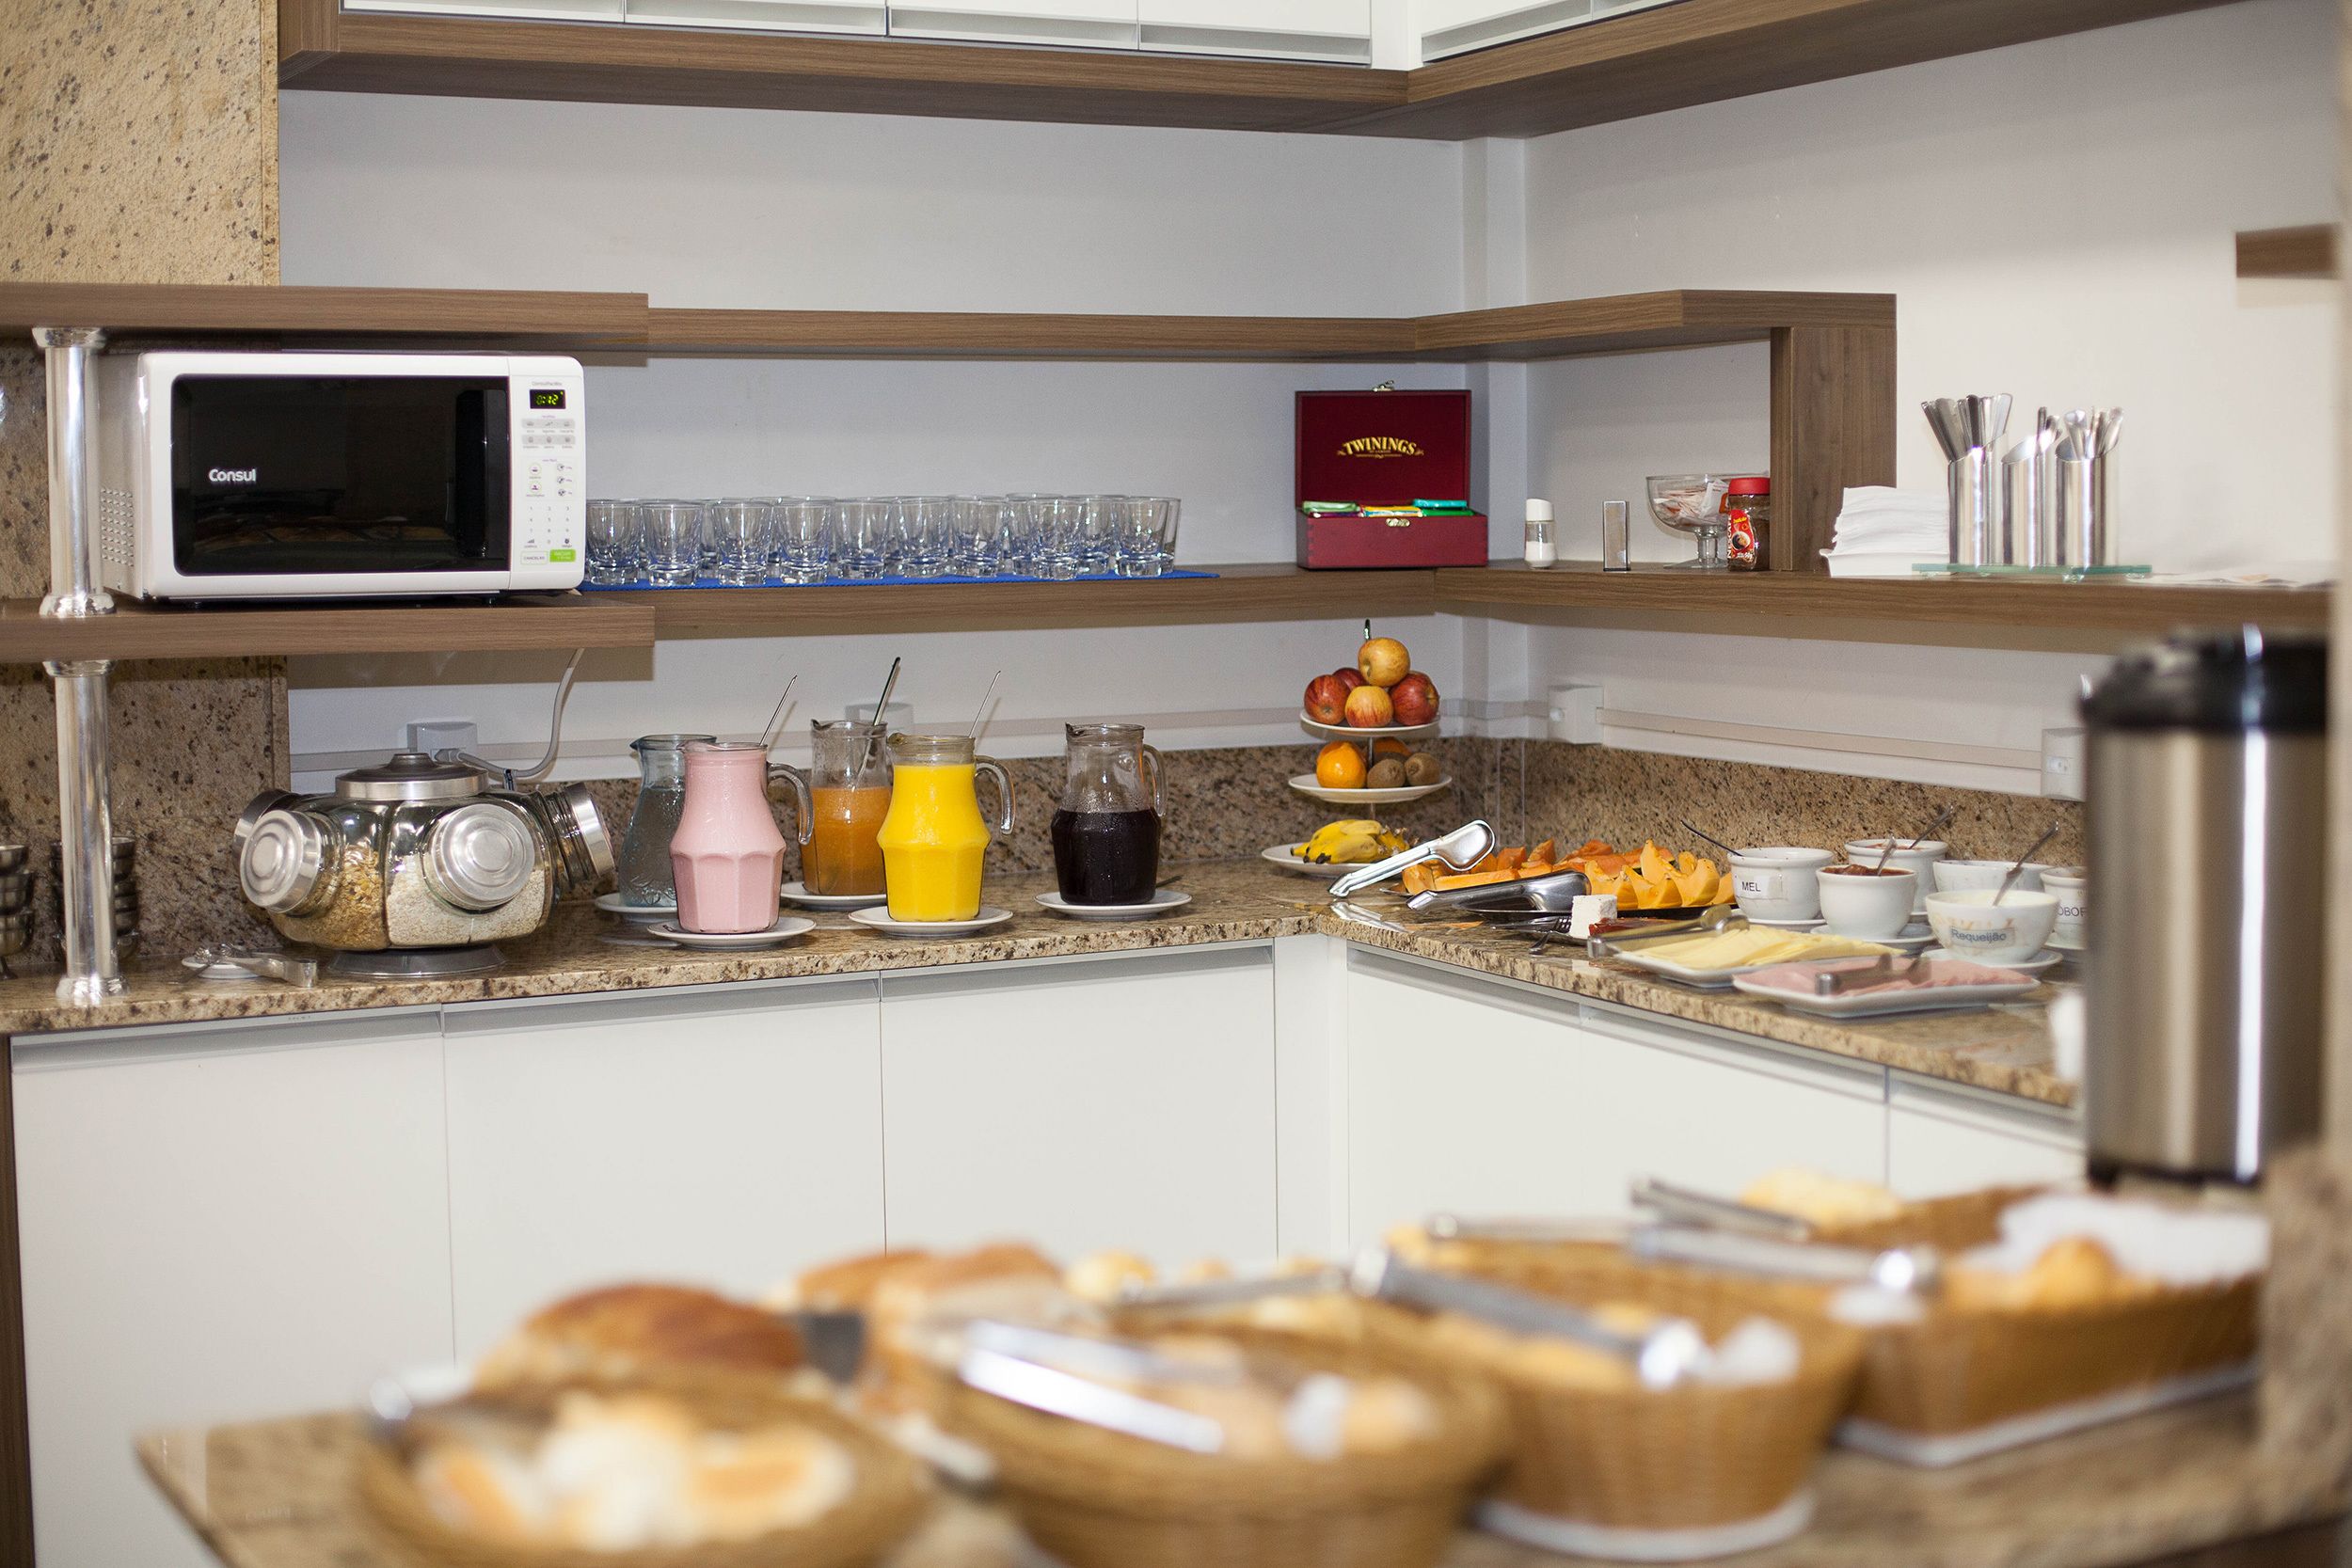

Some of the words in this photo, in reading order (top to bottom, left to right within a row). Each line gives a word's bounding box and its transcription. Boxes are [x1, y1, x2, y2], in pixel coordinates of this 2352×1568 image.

[1343, 436, 1417, 455] TWININGS
[208, 468, 257, 482] Consul
[1741, 881, 1761, 892] MEL
[1950, 928, 2007, 943] Requeijão
